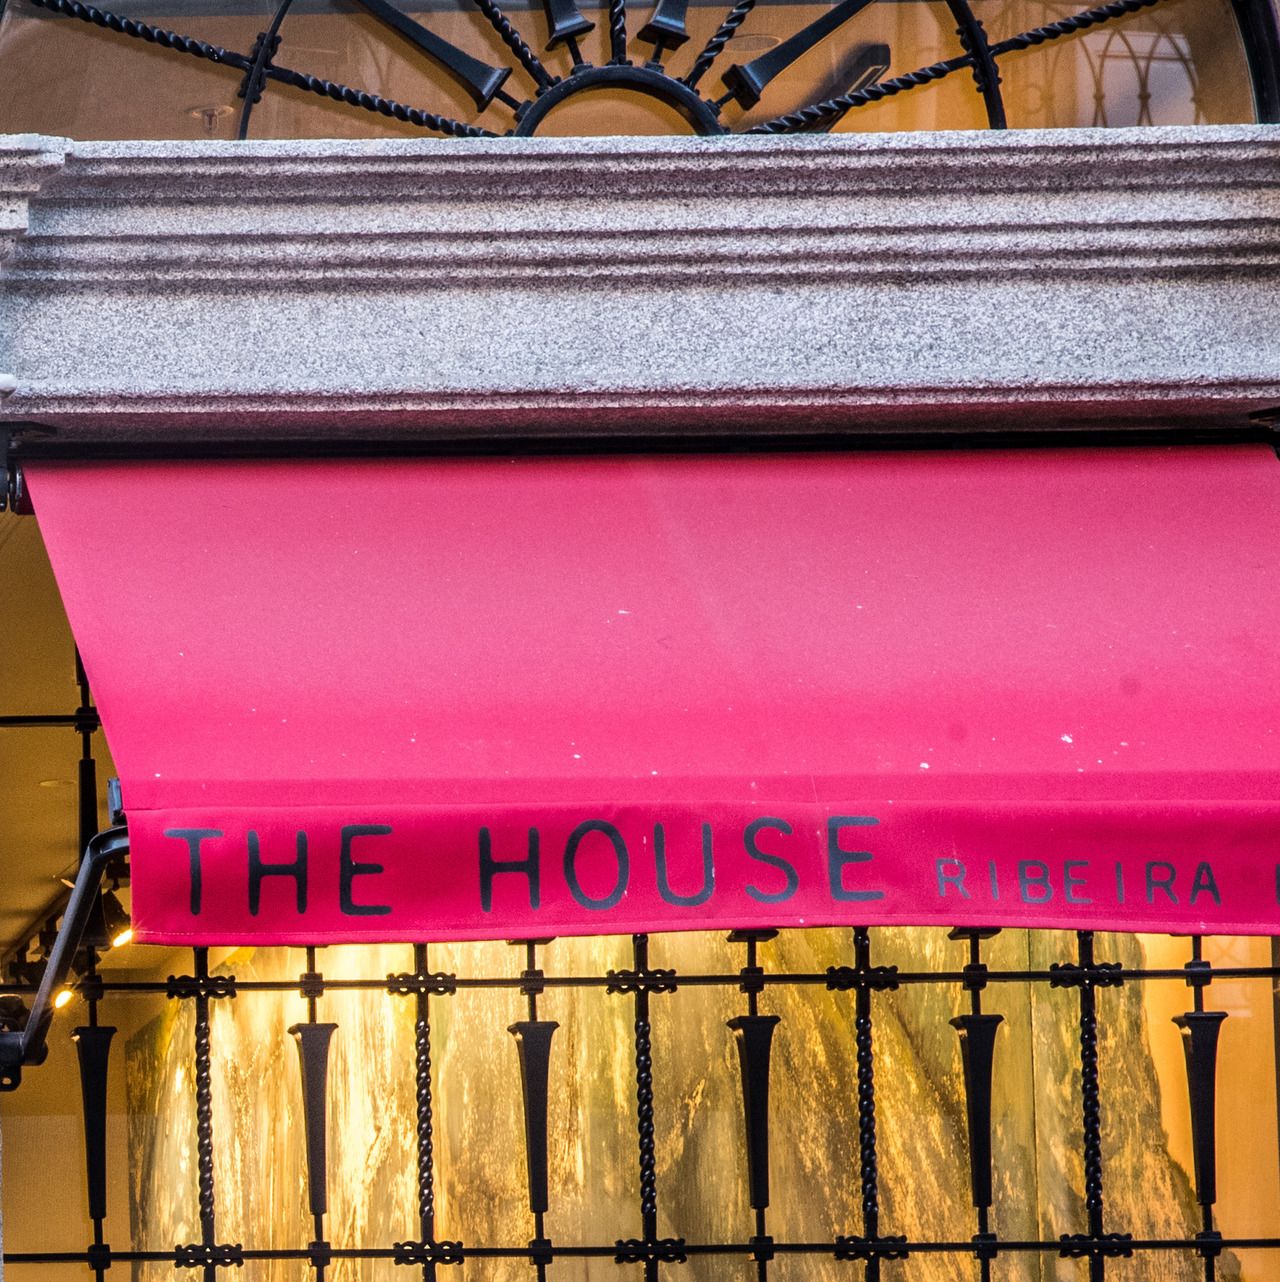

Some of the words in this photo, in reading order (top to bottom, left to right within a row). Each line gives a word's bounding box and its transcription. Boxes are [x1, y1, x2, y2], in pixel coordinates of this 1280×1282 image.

[163, 825, 393, 917] THE
[478, 815, 885, 913] HOUSE
[934, 858, 1222, 906] RIBEIRA
